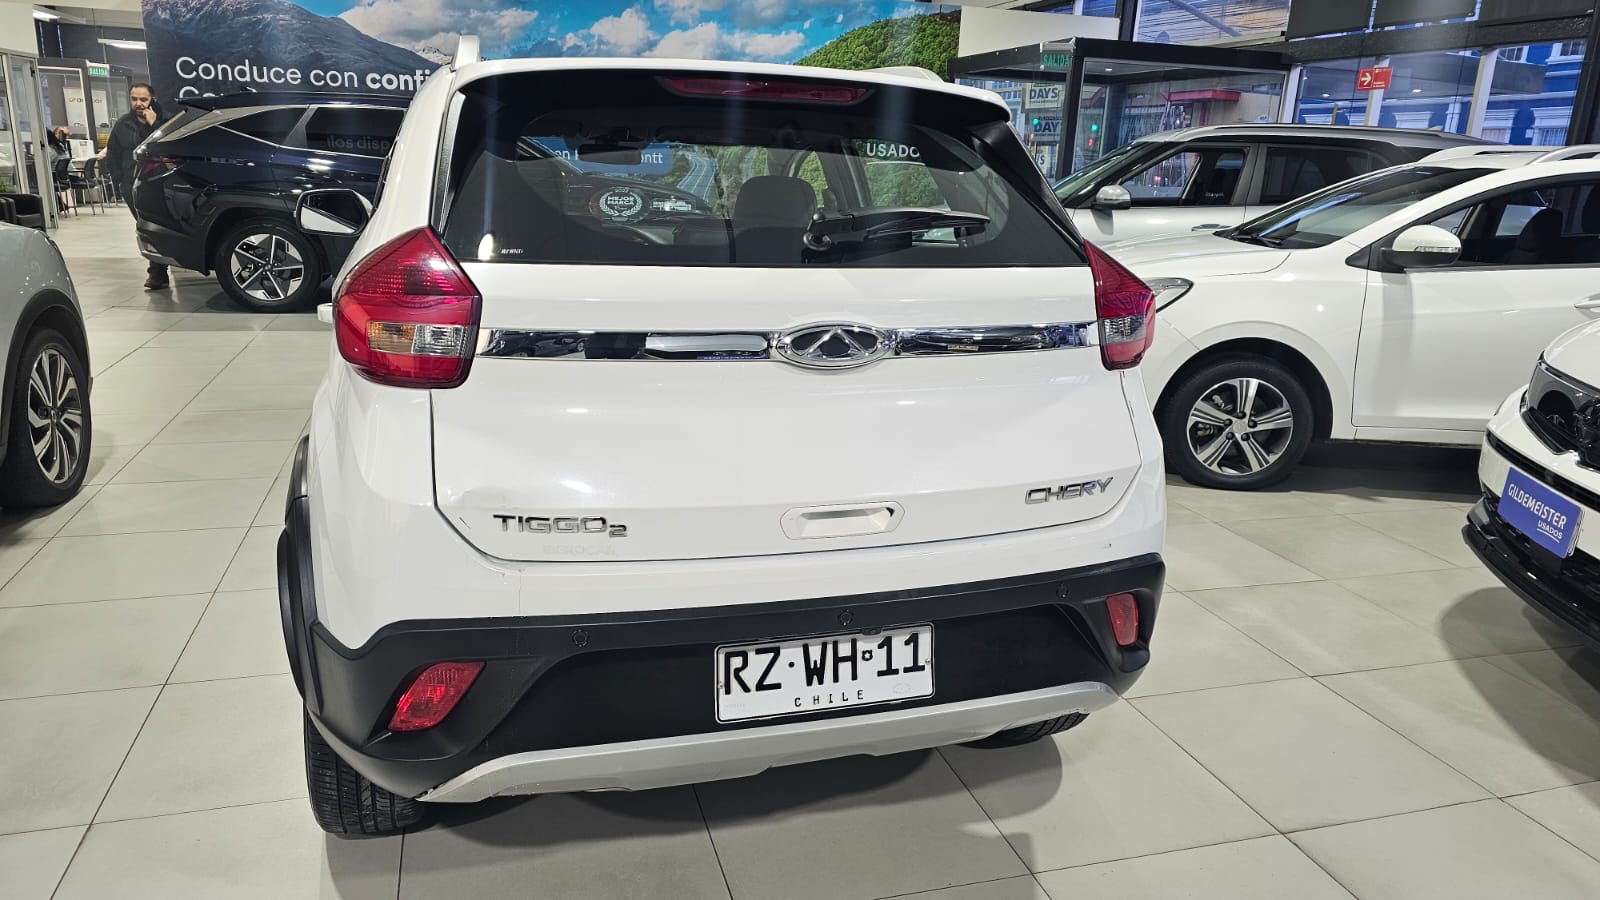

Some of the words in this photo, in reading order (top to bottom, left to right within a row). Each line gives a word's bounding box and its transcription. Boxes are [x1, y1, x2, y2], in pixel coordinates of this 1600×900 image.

[1043, 54, 1070, 67] SALIDA
[175, 56, 302, 85] Conduce
[310, 69, 358, 88] con
[1029, 87, 1058, 100] DAYS
[1025, 476, 1114, 505] CHERY
[1508, 483, 1567, 530] GILDEMEISTER
[1538, 520, 1563, 540] USADOS
[794, 689, 864, 708] CHILE
